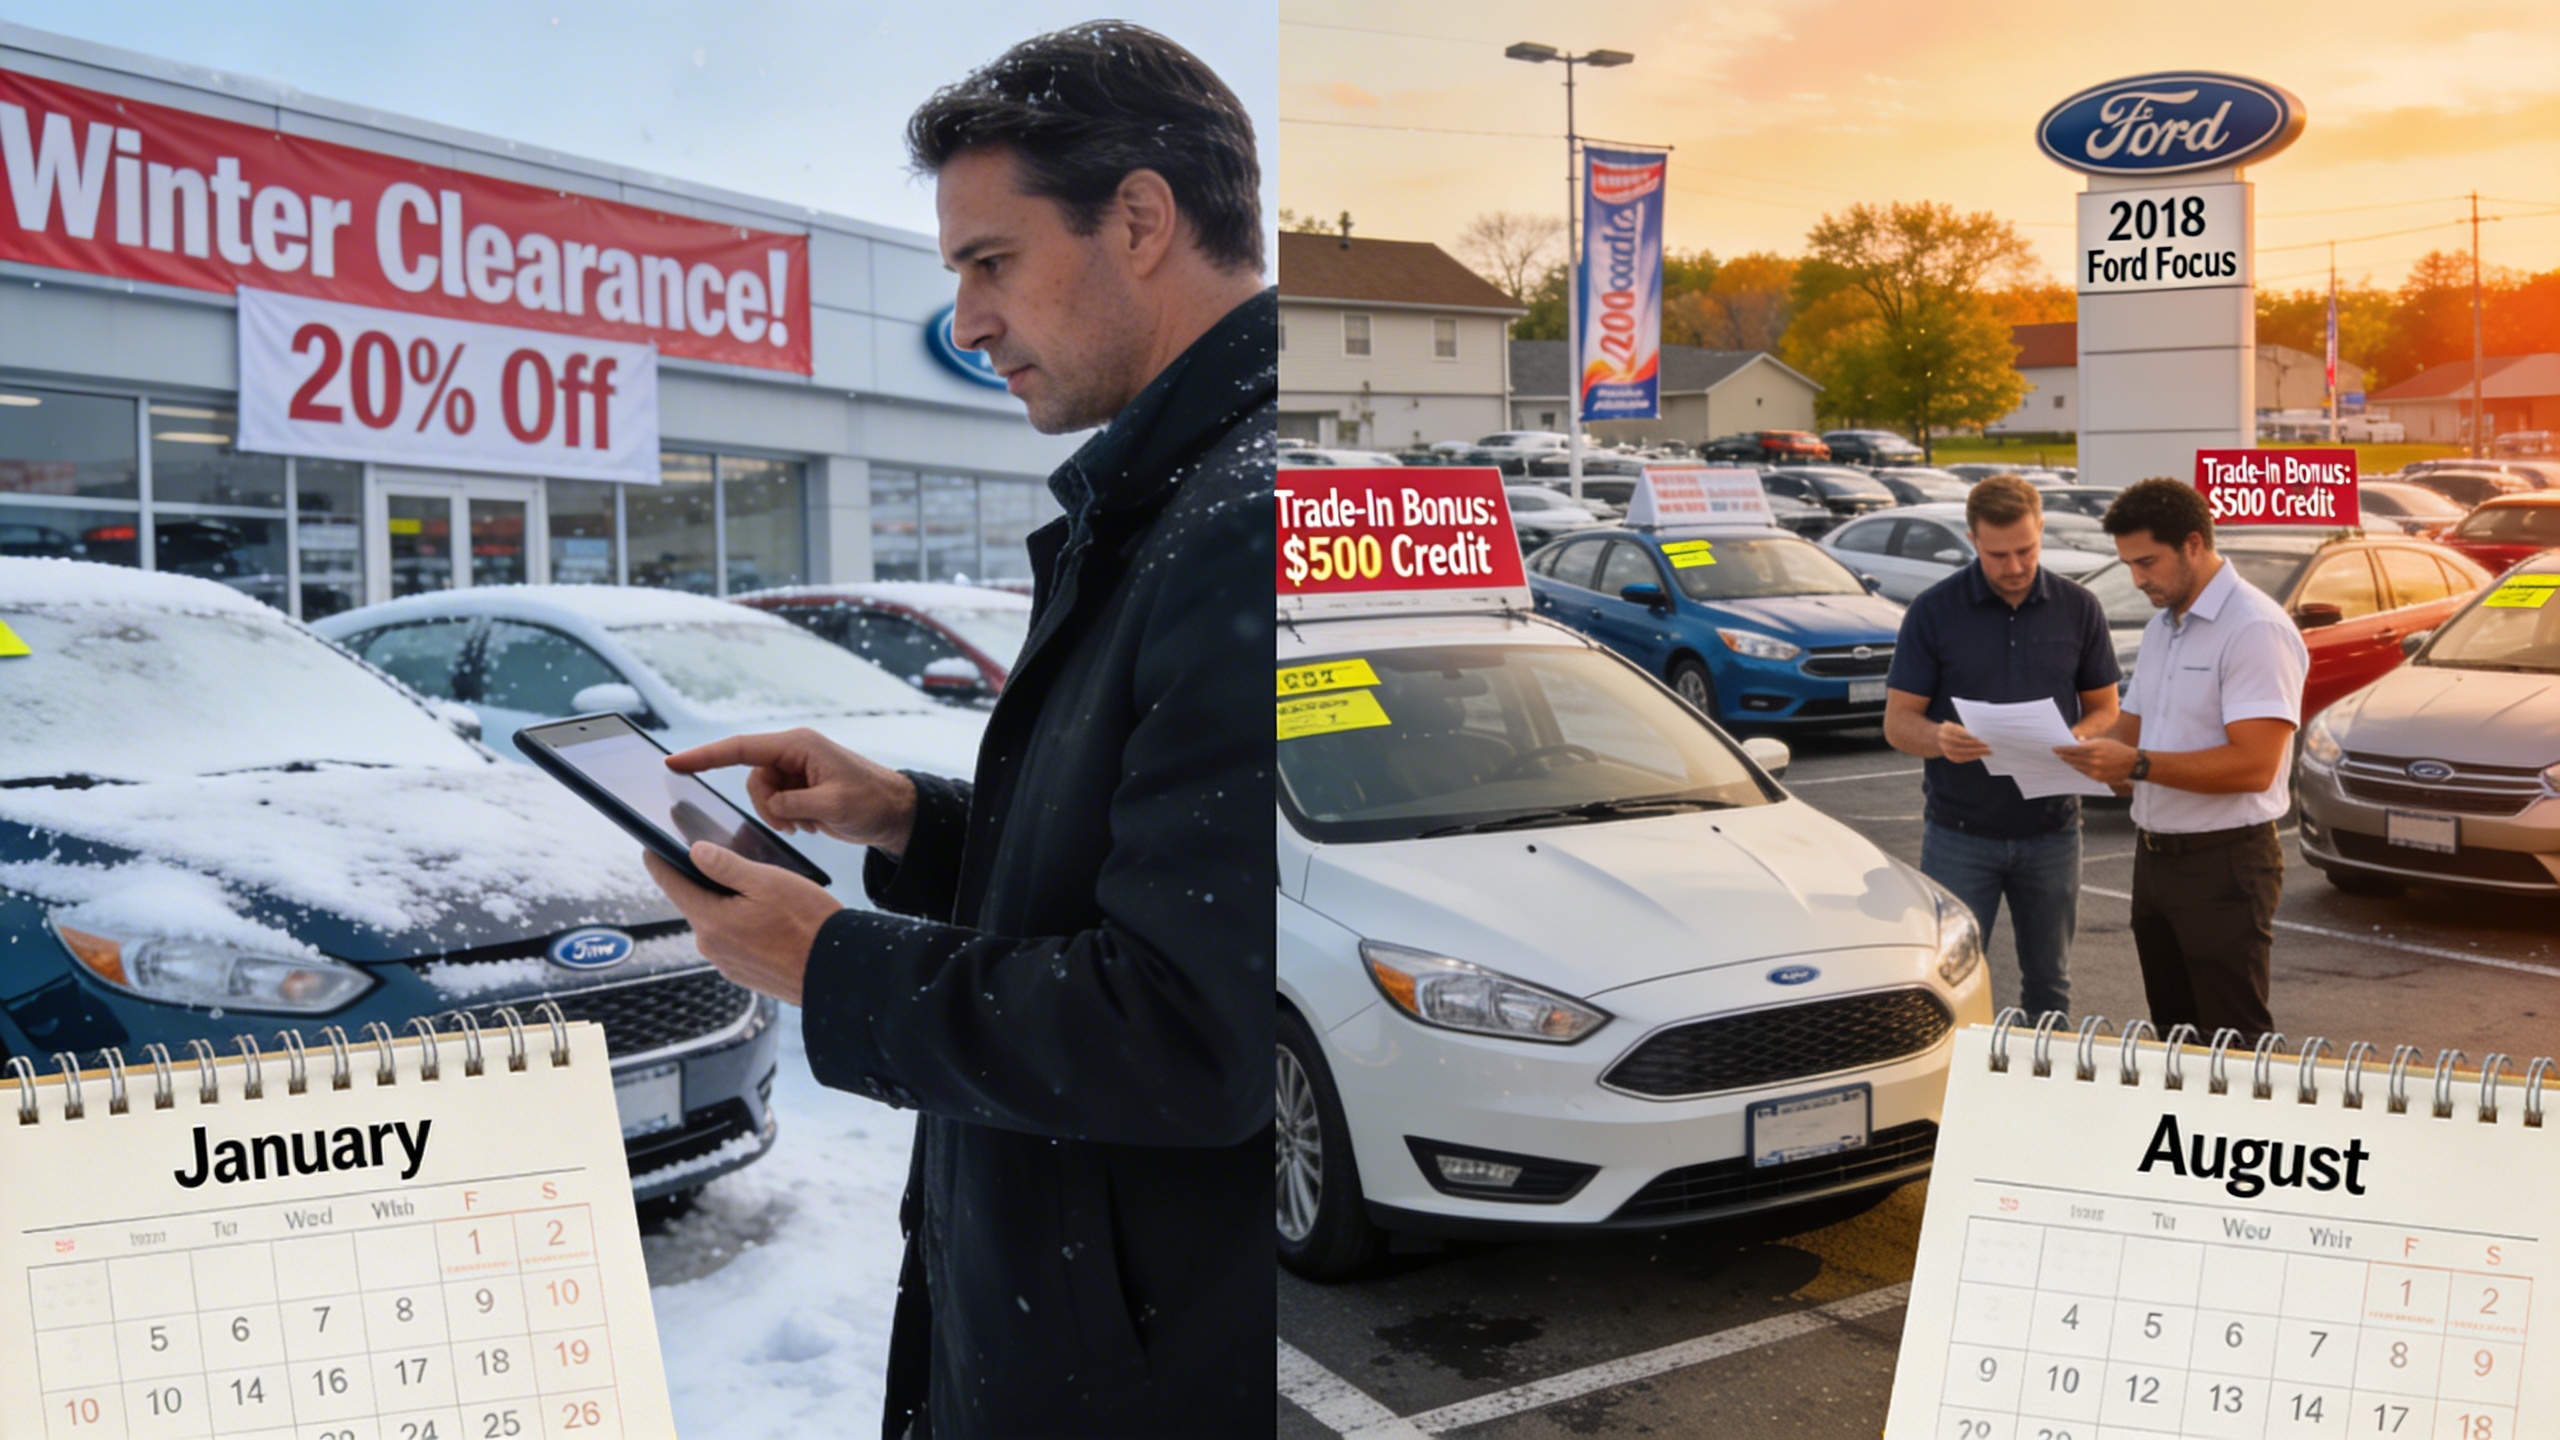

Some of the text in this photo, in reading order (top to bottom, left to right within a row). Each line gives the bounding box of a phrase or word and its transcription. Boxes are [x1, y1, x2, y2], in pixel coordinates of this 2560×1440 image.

[2085, 88, 2233, 160] Ford
[0, 101, 790, 348] Winter Clearance!
[2107, 195, 2206, 242] 2018
[2087, 246, 2237, 284] Ford Focus
[287, 322, 618, 451] 20% Off
[2202, 455, 2351, 485] Trade-In Bonus:
[1273, 487, 1498, 528] Trade-In Bonus:
[2208, 485, 2336, 519] $500 Credit
[1283, 531, 1492, 587] $500 Credit
[174, 1119, 432, 1189] January
[2137, 1113, 2370, 1198] August
[284, 1207, 333, 1231] Wed
[463, 1190, 479, 1212] F
[541, 1181, 558, 1201] S
[467, 1219, 566, 1255] 1 2
[2404, 1236, 2420, 1258] F
[2485, 1245, 2502, 1266] S
[150, 1278, 580, 1352] 5 6 7 8 9 10
[2399, 1278, 2500, 1316] 1 2
[2060, 1303, 2494, 1377] 4 5 6 7 8 9
[64, 1338, 591, 1426] 10 10 14 16 17 18 19
[1978, 1356, 2494, 1440] 9 10 12 13 14 17 18
[400, 1400, 601, 1440] 24 25 26
